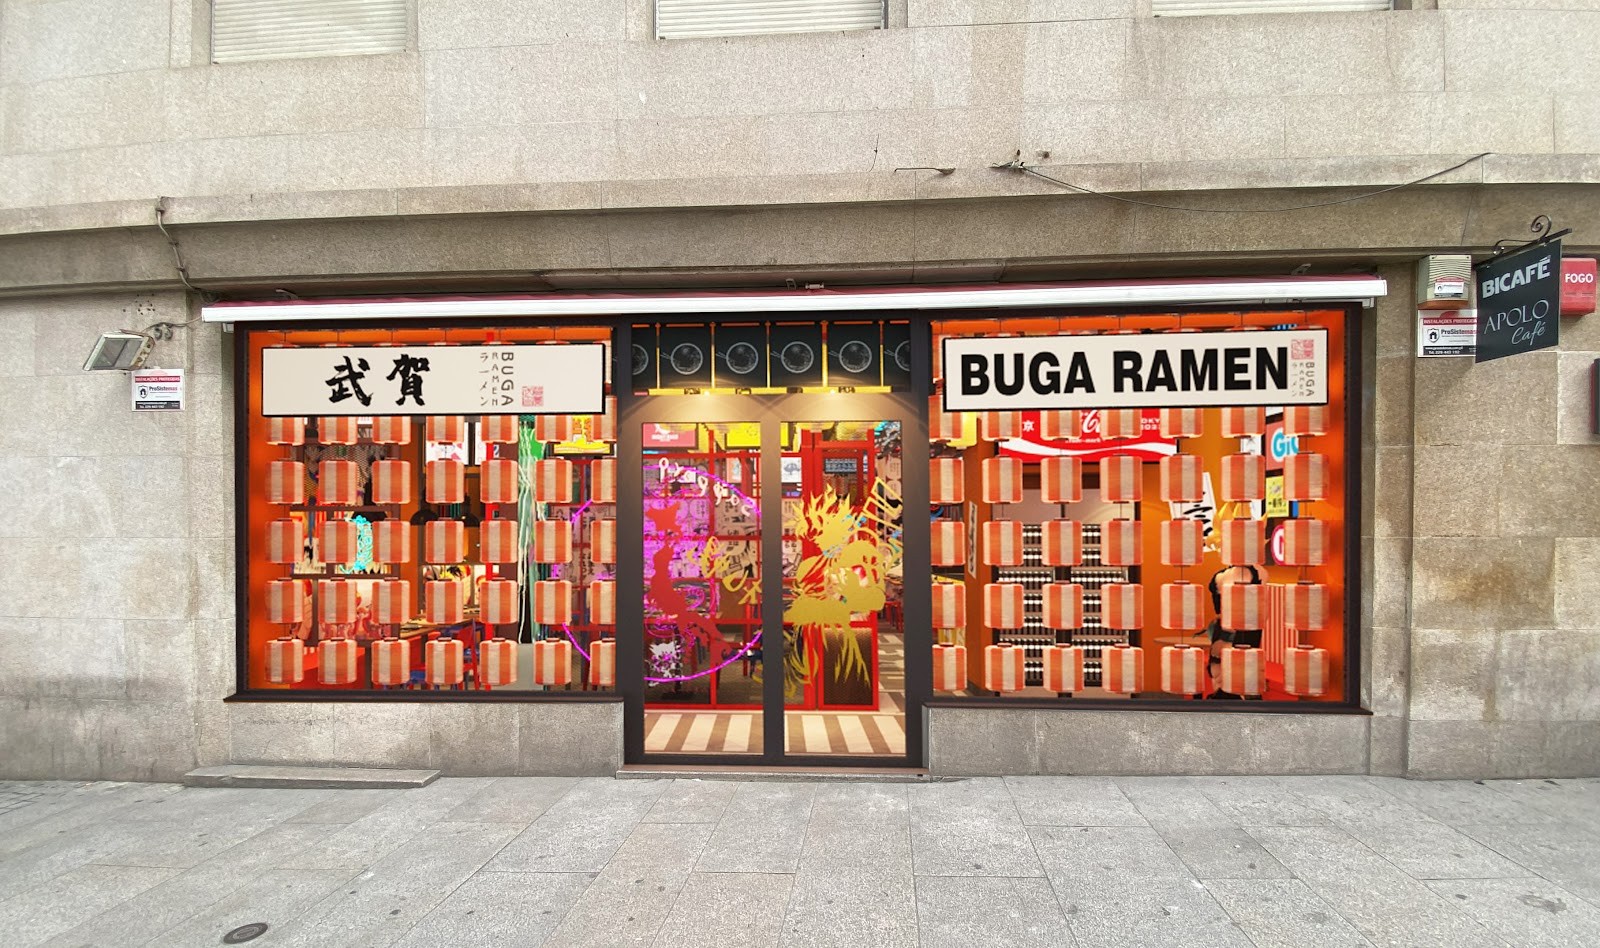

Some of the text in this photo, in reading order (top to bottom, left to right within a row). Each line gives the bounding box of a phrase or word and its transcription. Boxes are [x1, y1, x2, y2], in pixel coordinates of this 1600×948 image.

[1482, 255, 1551, 299] BICAFÉ
[1565, 273, 1594, 284] FOGO
[1484, 300, 1549, 335] APOLO
[1511, 321, 1546, 346] Café
[325, 353, 430, 407] 武賀
[479, 352, 489, 406] ラーメン
[501, 352, 514, 406] BUGA
[961, 352, 1095, 396] BUGA
[1113, 346, 1288, 392] RAMEN
[1305, 362, 1315, 397] BUGA
